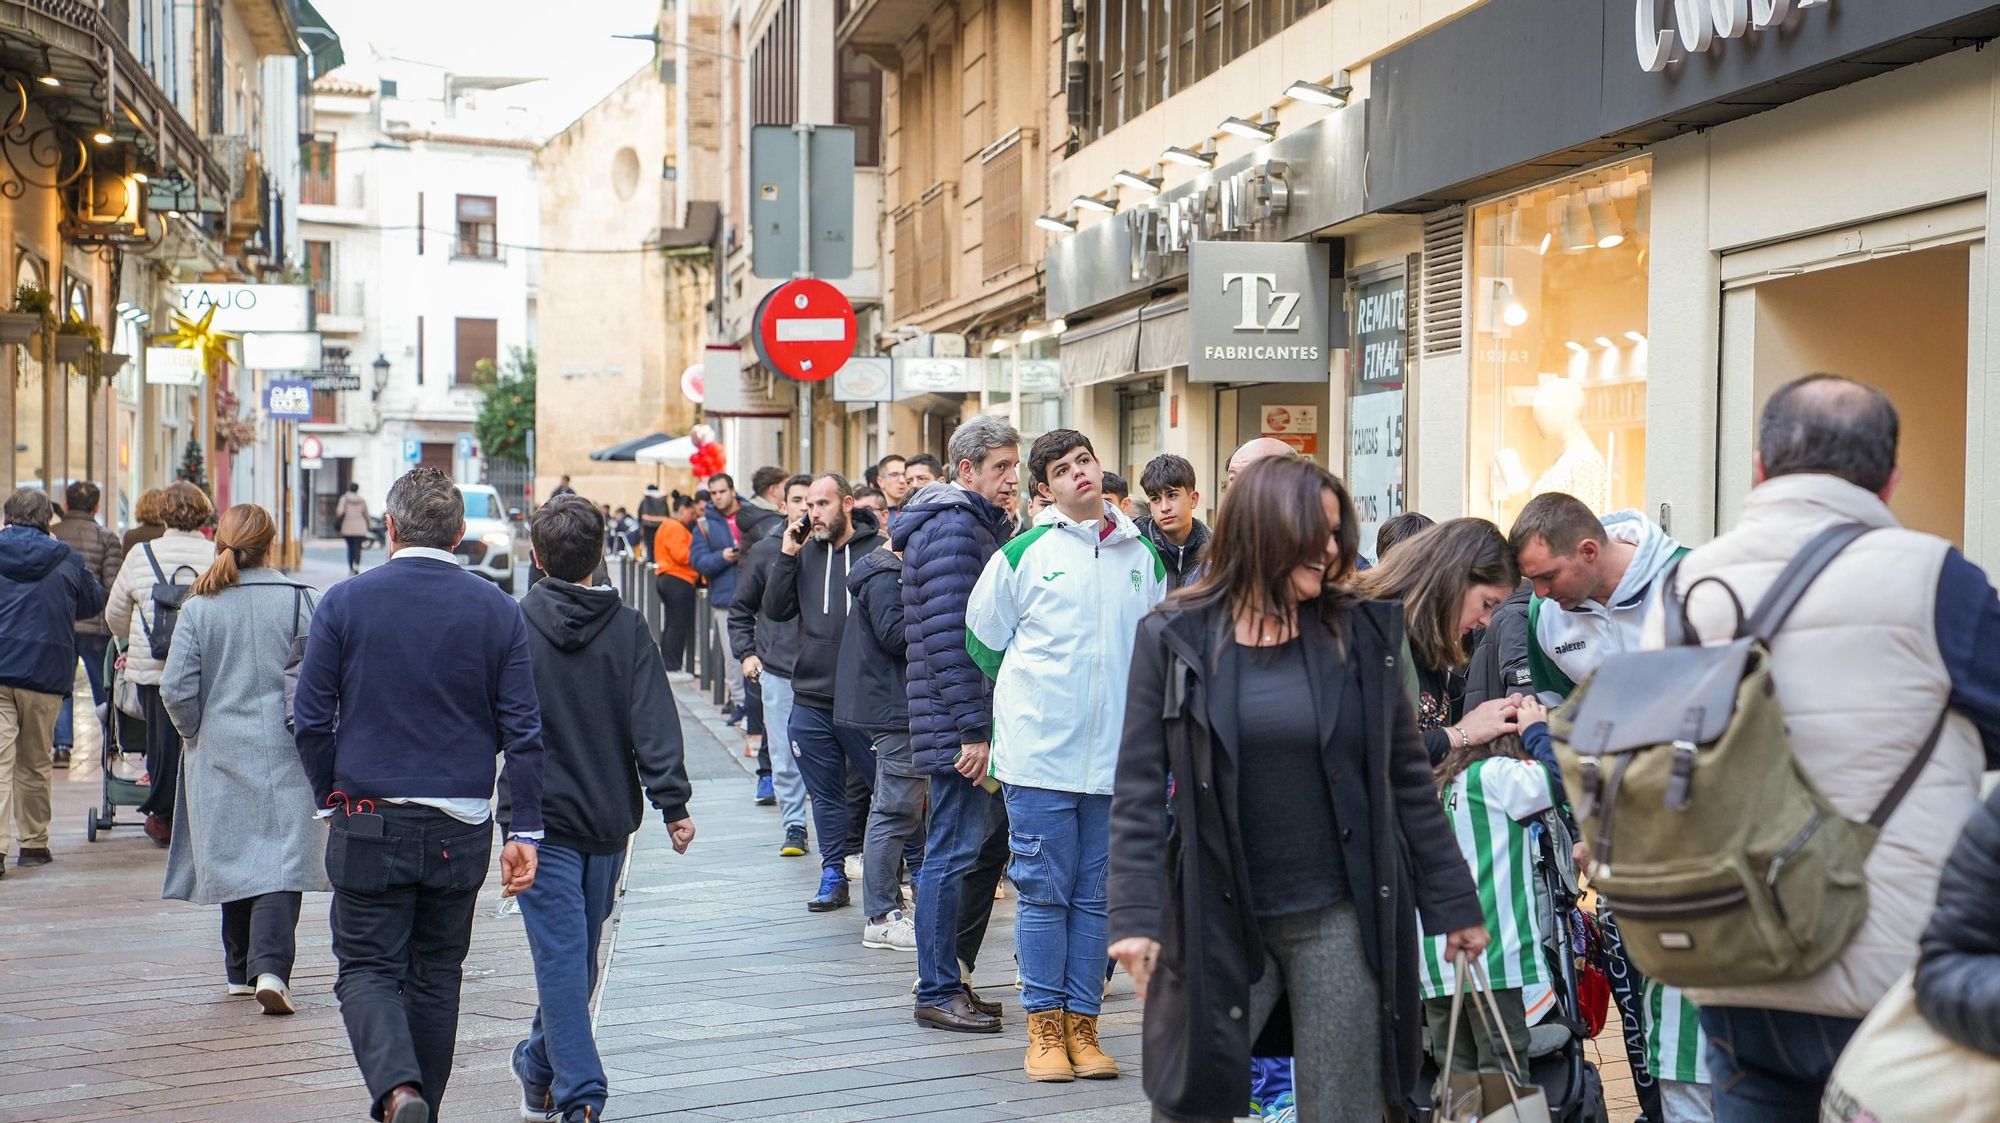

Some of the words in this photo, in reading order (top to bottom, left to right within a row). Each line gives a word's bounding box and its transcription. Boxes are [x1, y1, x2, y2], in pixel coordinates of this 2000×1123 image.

[1222, 272, 1301, 330] Tz
[1357, 289, 1405, 335] REMATE
[1204, 346, 1319, 361] FABRICANTES
[1363, 339, 1400, 381] FINAL
[1354, 426, 1379, 457] CAMISAS
[1561, 640, 1587, 653] alexen
